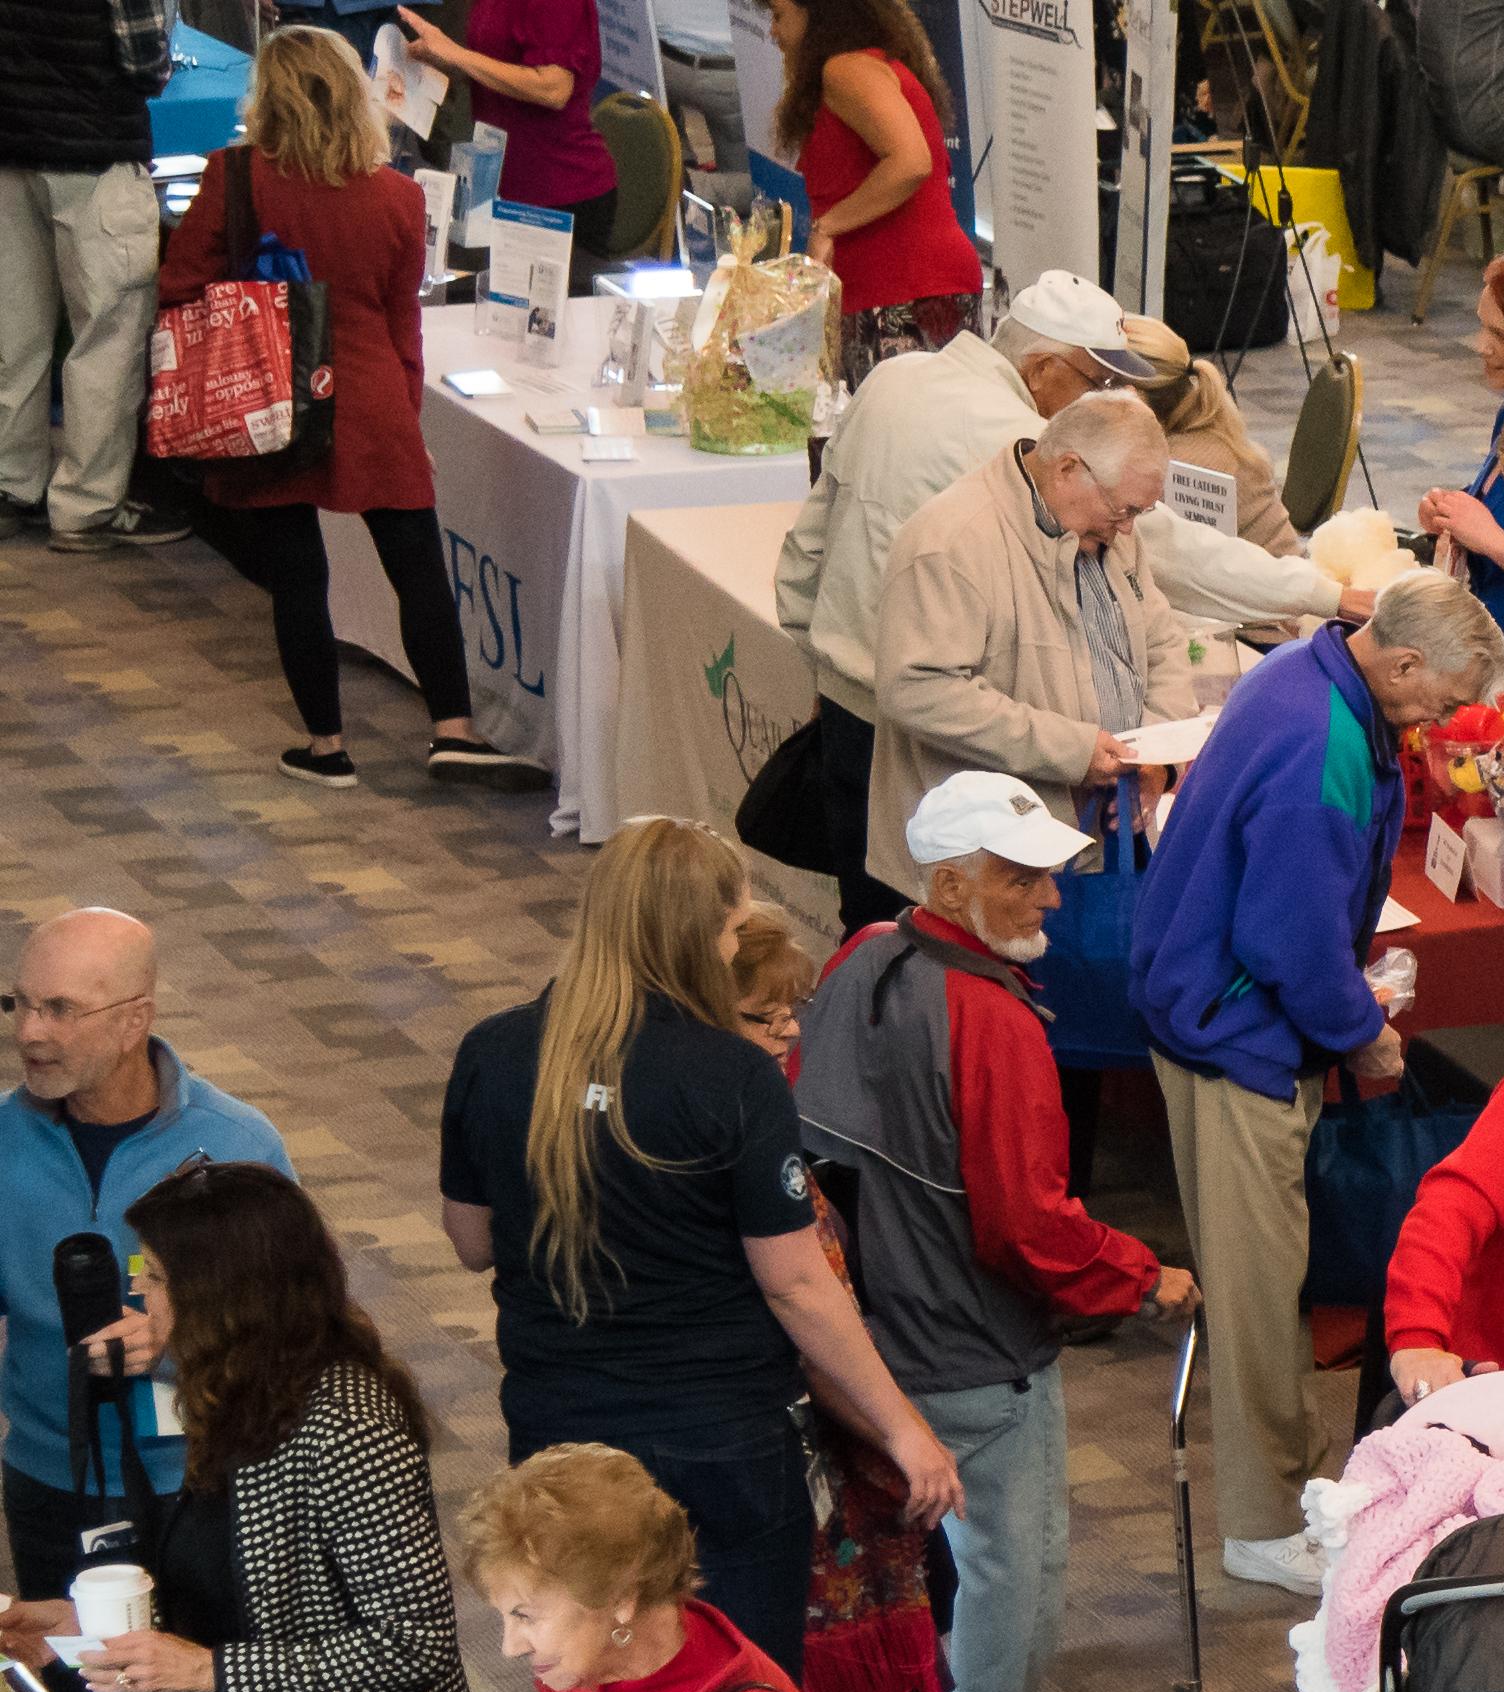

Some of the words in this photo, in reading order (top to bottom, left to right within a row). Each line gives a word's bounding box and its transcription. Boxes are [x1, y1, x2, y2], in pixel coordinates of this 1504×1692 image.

[1172, 473, 1190, 487] FREE
[1193, 479, 1227, 497] CATERED
[1174, 492, 1200, 506] LIVING
[1202, 499, 1225, 514] TRUST
